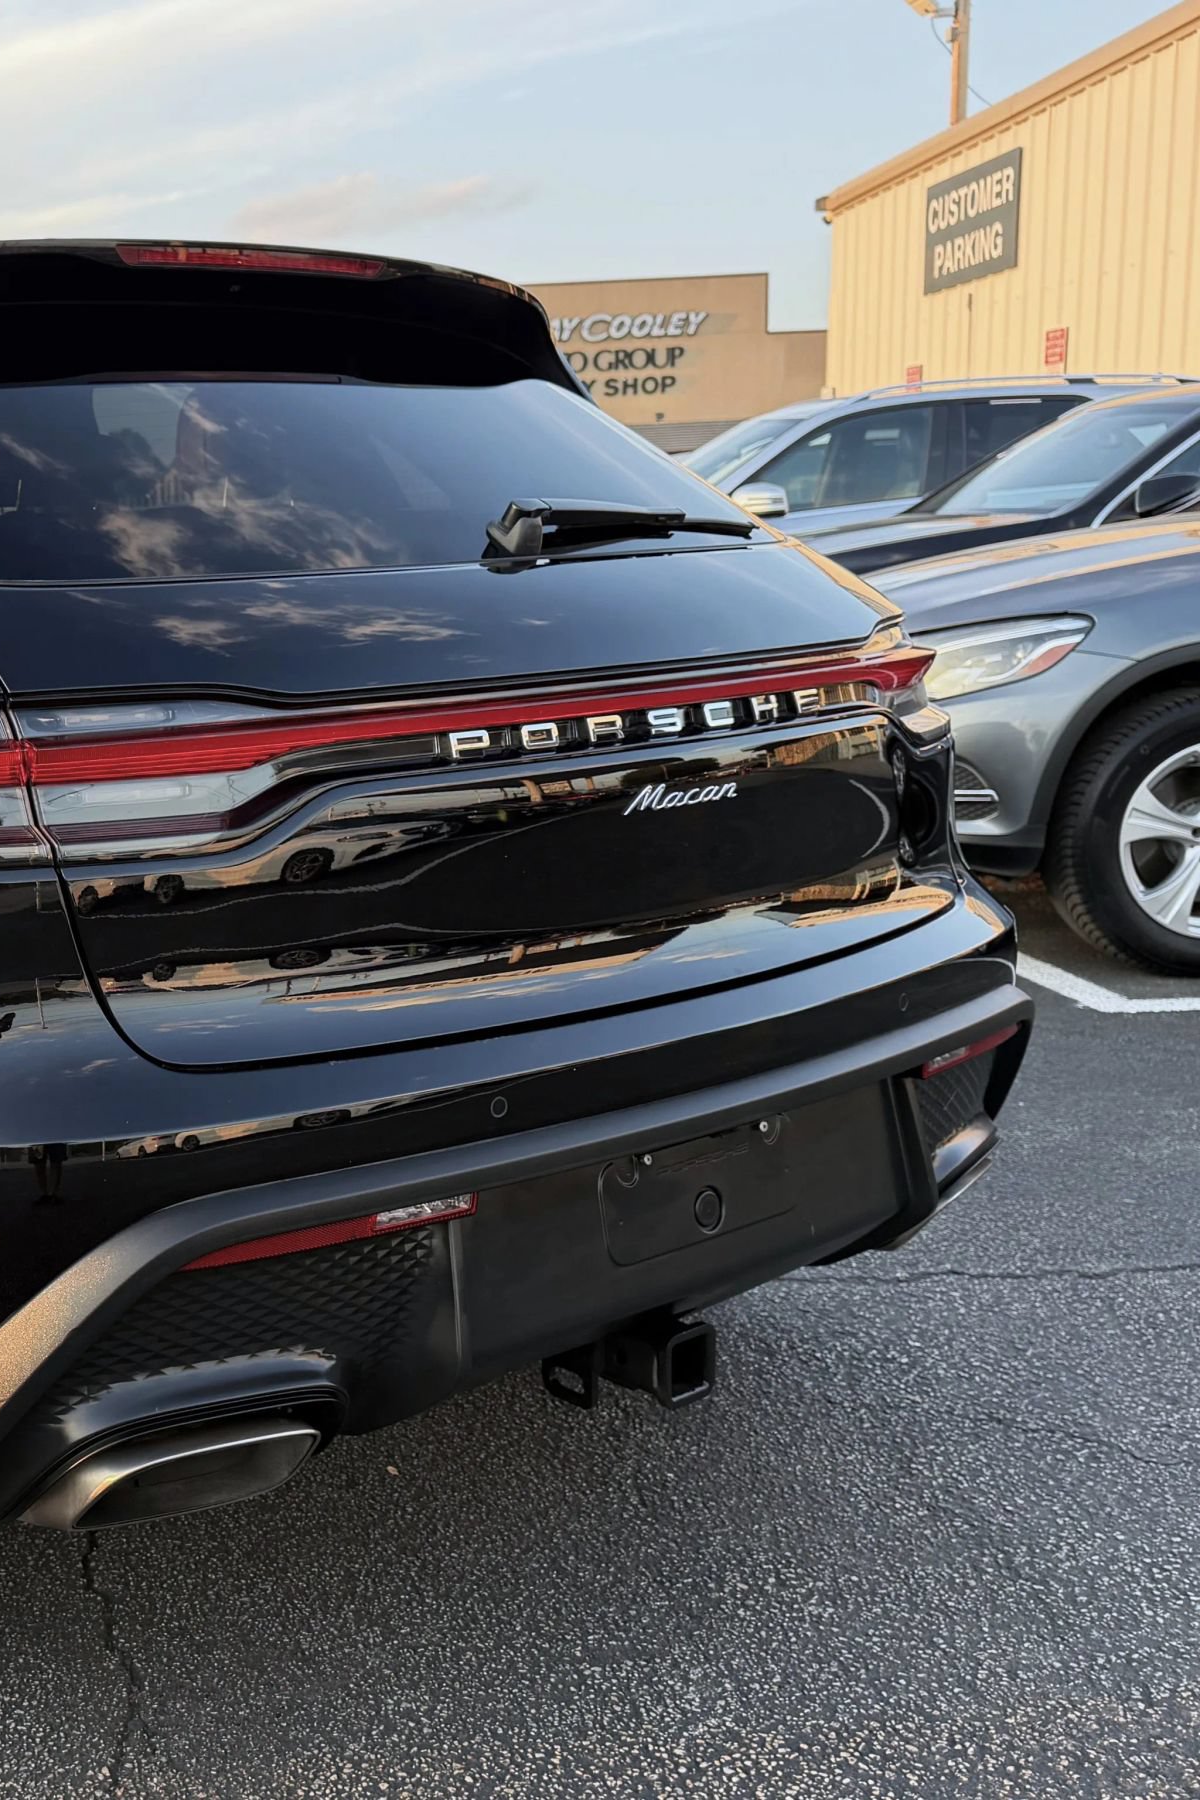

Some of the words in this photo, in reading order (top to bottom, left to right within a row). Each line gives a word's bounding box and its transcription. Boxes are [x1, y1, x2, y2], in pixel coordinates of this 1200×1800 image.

[927, 166, 1015, 234] CUSTOMER
[933, 221, 1003, 279] PARKING
[581, 312, 708, 343] COOLEY
[593, 346, 684, 372] GROUP
[604, 375, 676, 396] SHOP
[449, 688, 820, 759] PORSCHE
[623, 779, 738, 816] Macan
